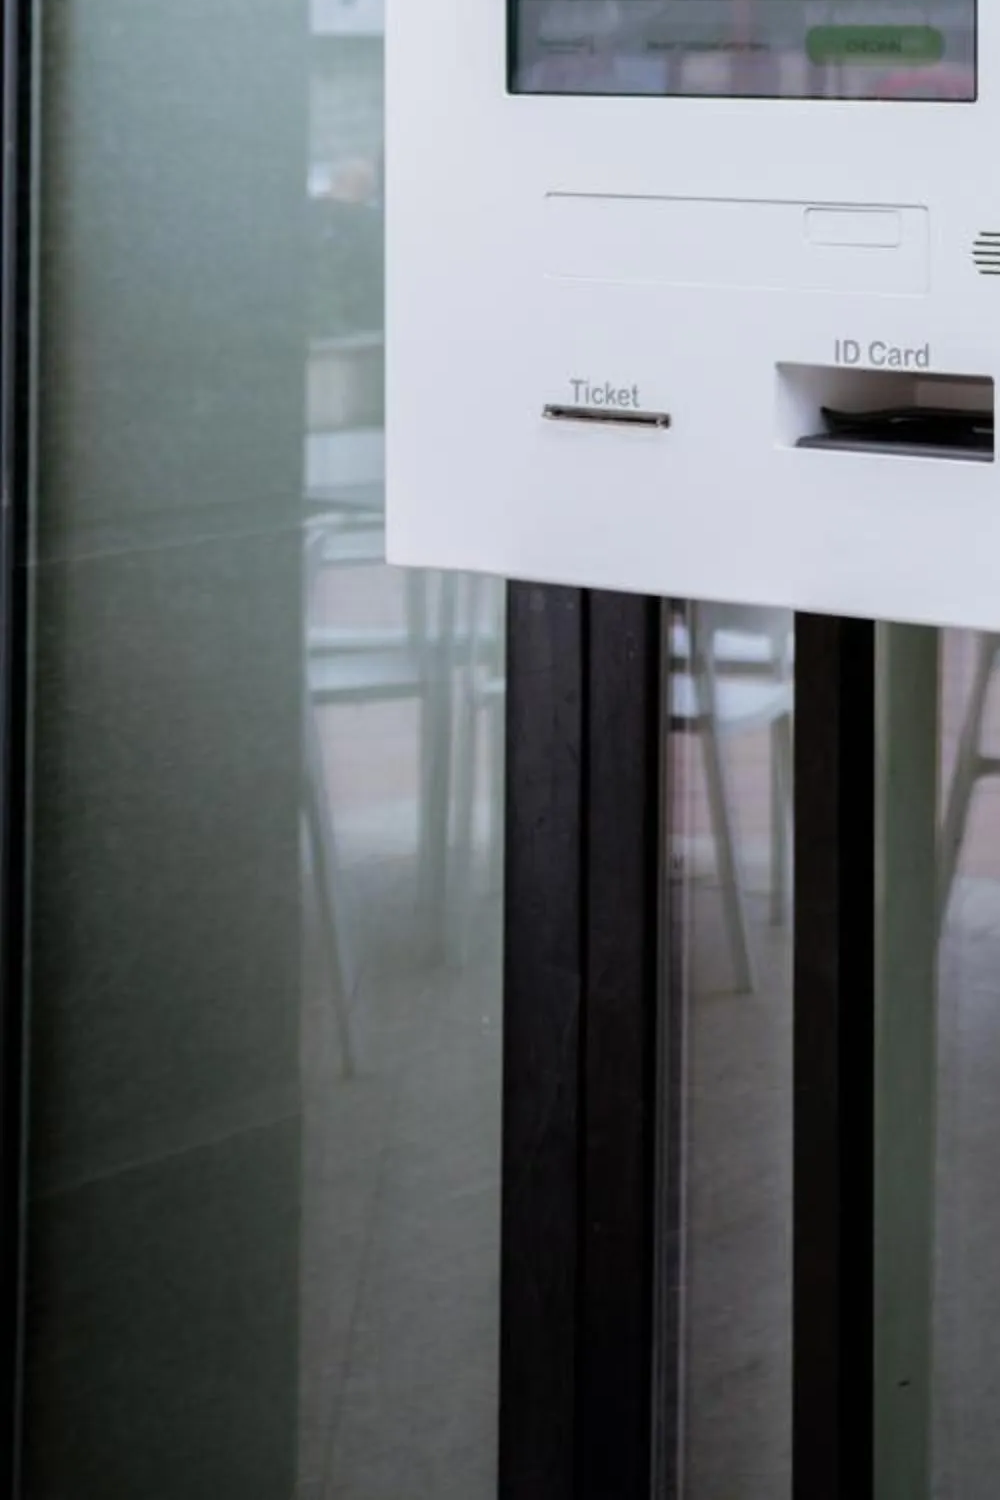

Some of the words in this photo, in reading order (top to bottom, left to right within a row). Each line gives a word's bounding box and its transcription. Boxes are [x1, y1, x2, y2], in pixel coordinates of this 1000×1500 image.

[834, 338, 861, 365] ID
[867, 339, 930, 368] Card
[569, 378, 641, 408] Ticket
